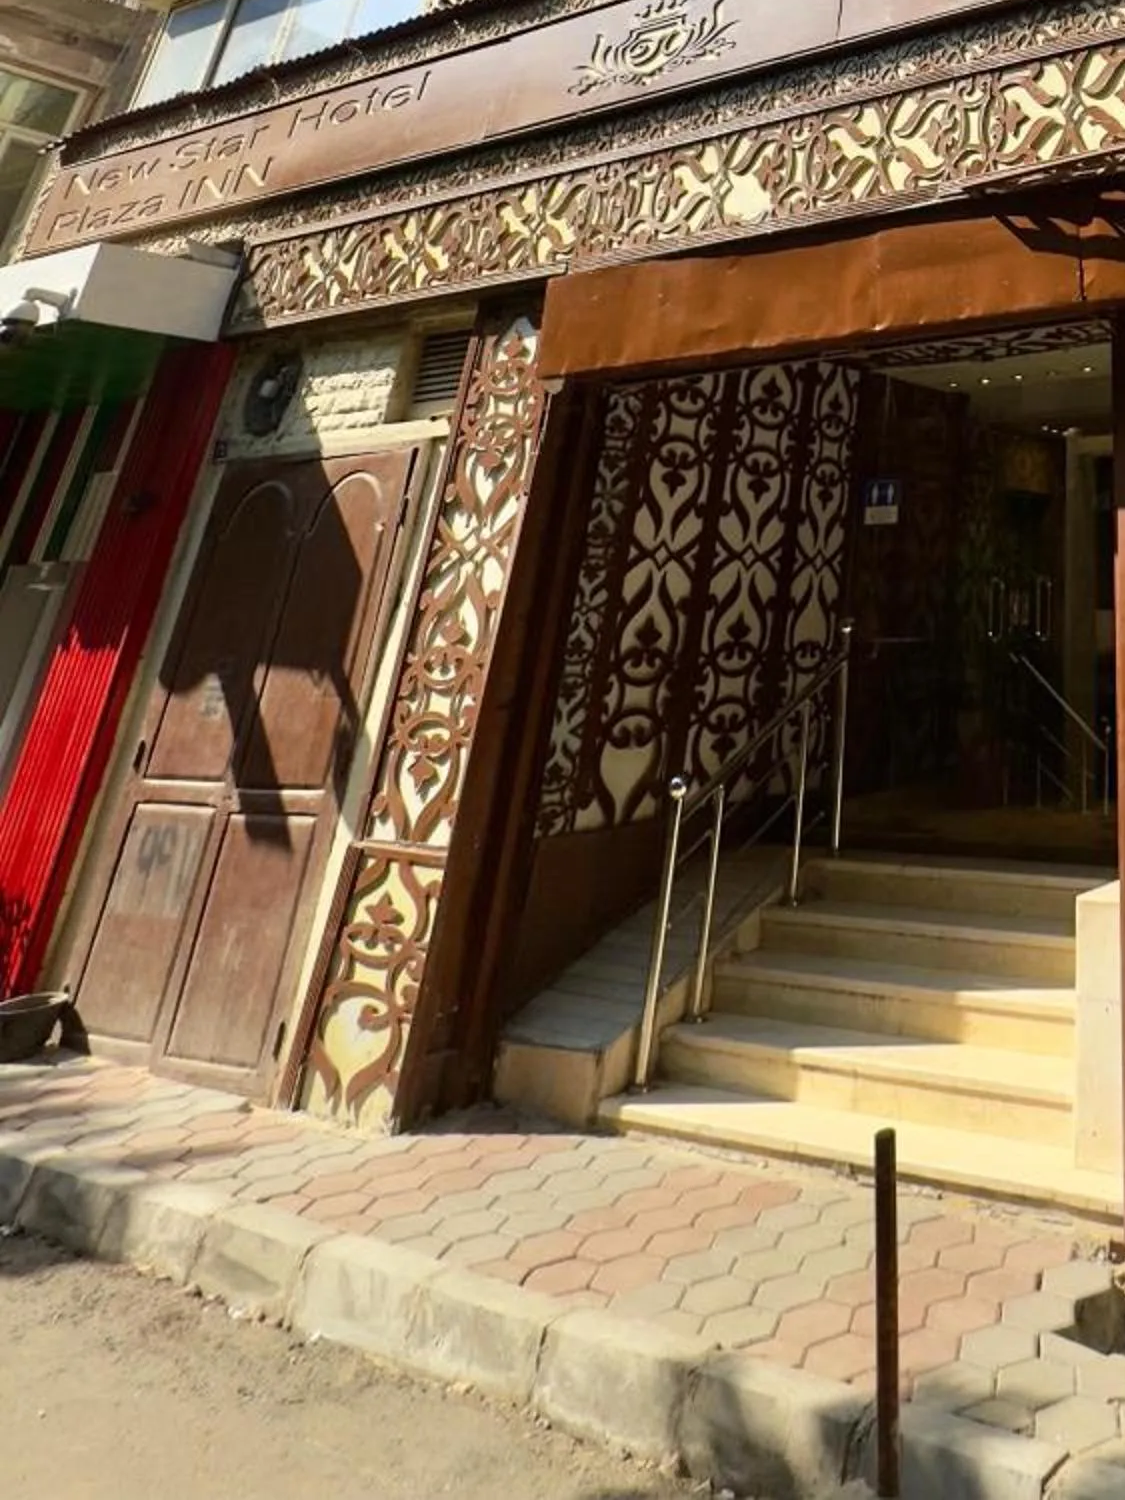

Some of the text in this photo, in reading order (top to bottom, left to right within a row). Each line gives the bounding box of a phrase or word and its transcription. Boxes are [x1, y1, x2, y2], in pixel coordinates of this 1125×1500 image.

[64, 69, 432, 200] New Star Hotel
[46, 156, 276, 241] Plaza INN
